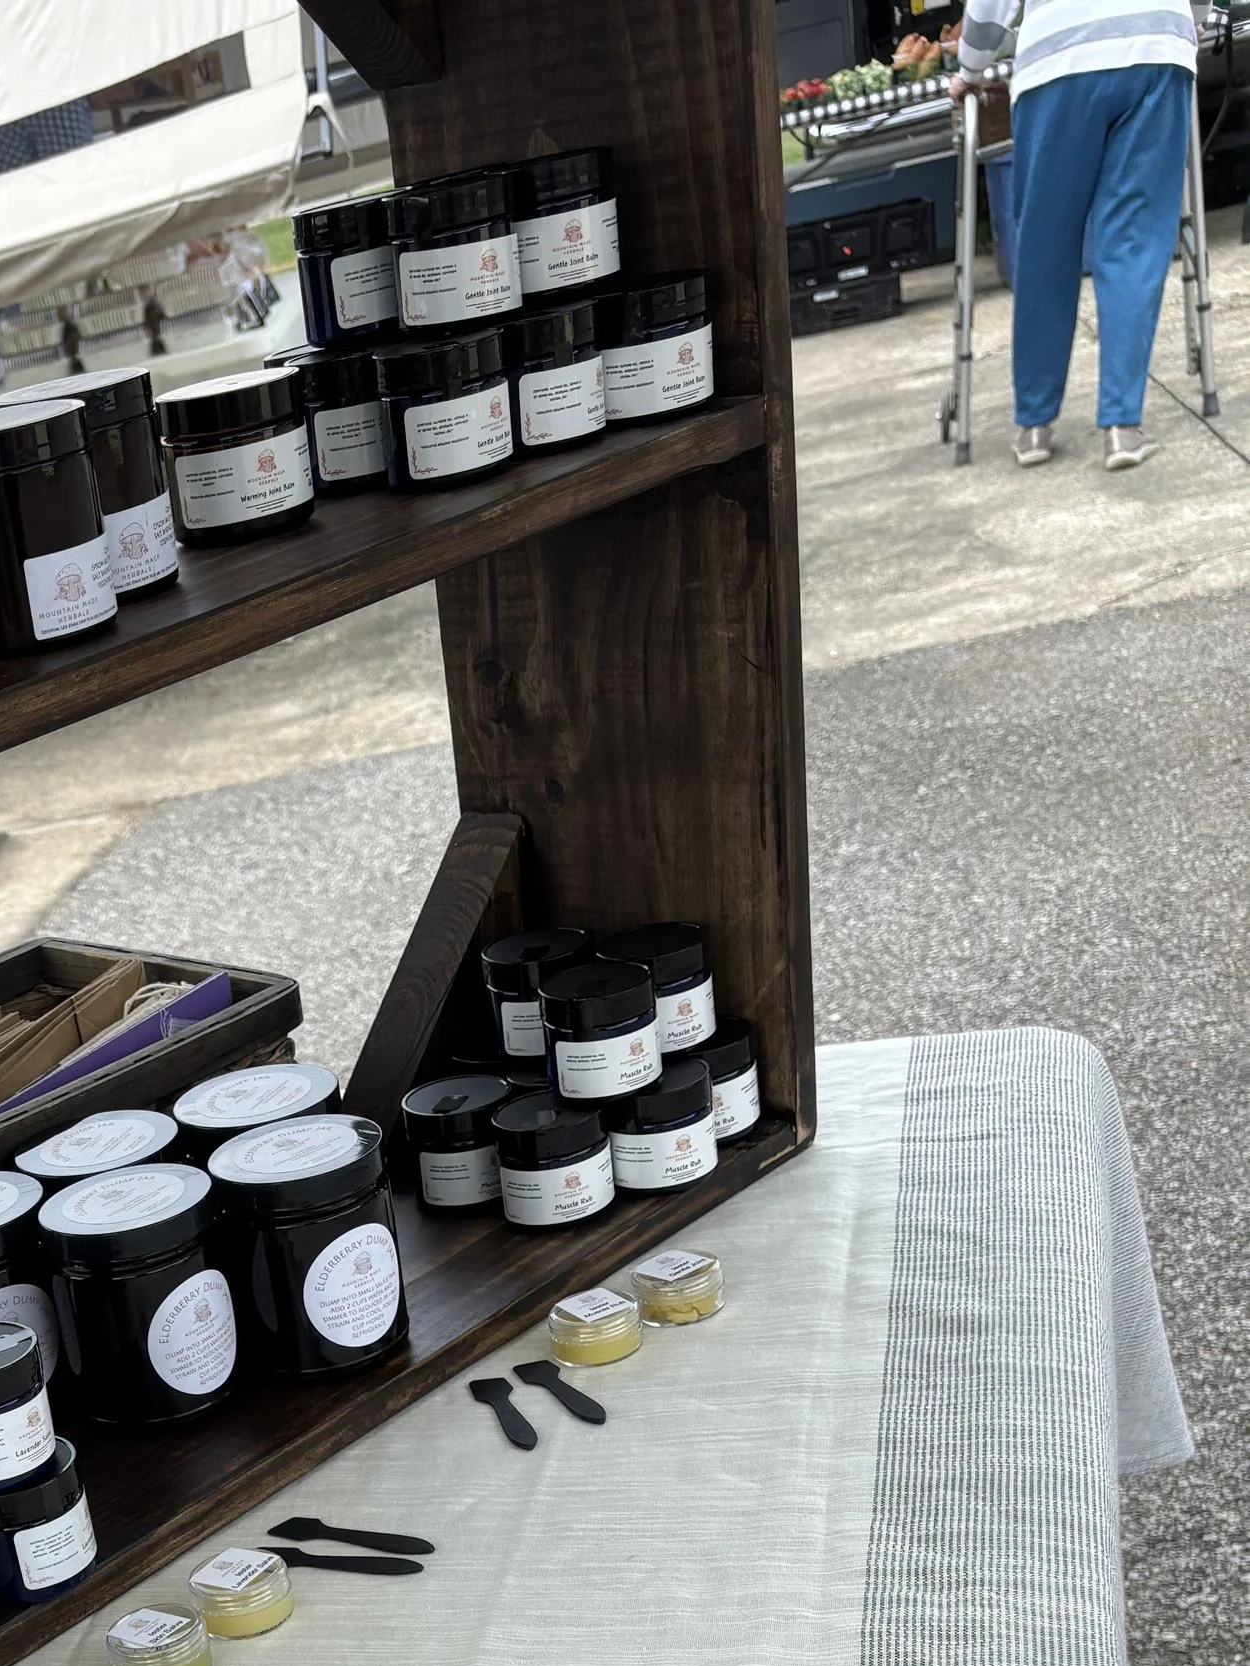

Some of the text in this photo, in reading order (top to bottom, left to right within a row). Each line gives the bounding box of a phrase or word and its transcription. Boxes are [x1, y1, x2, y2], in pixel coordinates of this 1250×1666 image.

[548, 253, 599, 271] Gentle Joint Balm
[465, 288, 485, 300] Gentle
[485, 286, 499, 298] Joint
[662, 381, 681, 393] Gentle
[682, 378, 695, 390] Joint
[240, 482, 295, 503] Warming Joint Balm
[38, 603, 80, 620] MOUNTAIN
[667, 1024, 702, 1039] Muscle Rub
[620, 1063, 653, 1080] Muscle Rub
[722, 1116, 735, 1125] Rub
[665, 1159, 701, 1174] Muscle Rub
[555, 1196, 593, 1211] Muscle Rub
[315, 1239, 363, 1291] ELDERBERRY
[320, 1297, 340, 1308] DUMP
[341, 1291, 357, 1303] INTO
[159, 1287, 200, 1344] ELDERBERRY
[323, 1310, 349, 1323] SIMMER
[350, 1307, 357, 1316] TO
[330, 1304, 345, 1313] ADD
[327, 1319, 350, 1330] STRAIN
[352, 1314, 365, 1324] AND
[165, 1341, 201, 1360] DUMP INTO
[177, 1355, 191, 1363] ADD
[175, 1362, 209, 1380] STRAIN AND
[16, 1441, 42, 1458] Lavender
[231, 1556, 275, 1589] Lavender Salve
